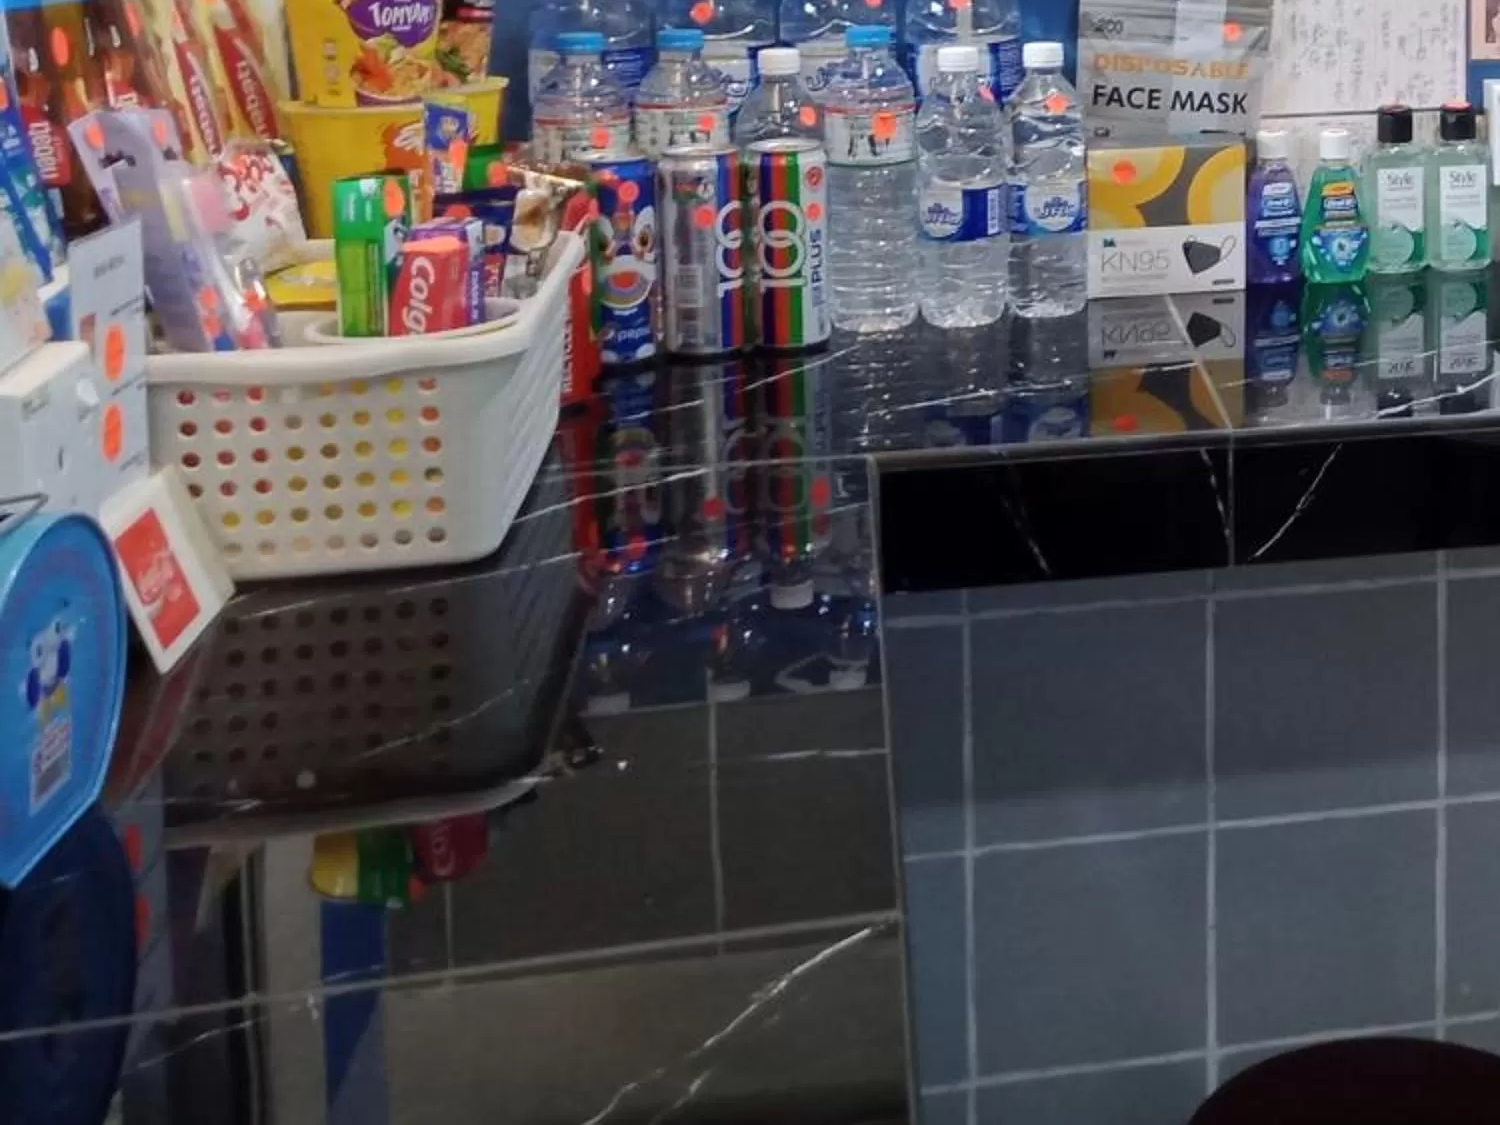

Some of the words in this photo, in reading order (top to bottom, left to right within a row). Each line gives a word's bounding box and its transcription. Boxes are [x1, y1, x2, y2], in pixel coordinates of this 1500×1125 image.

[1093, 52, 1249, 80] DISPOSABLE
[1092, 83, 1162, 110] FACE
[1170, 89, 1249, 115] MASK
[1100, 247, 1171, 273] KN95
[401, 255, 436, 335] Colg
